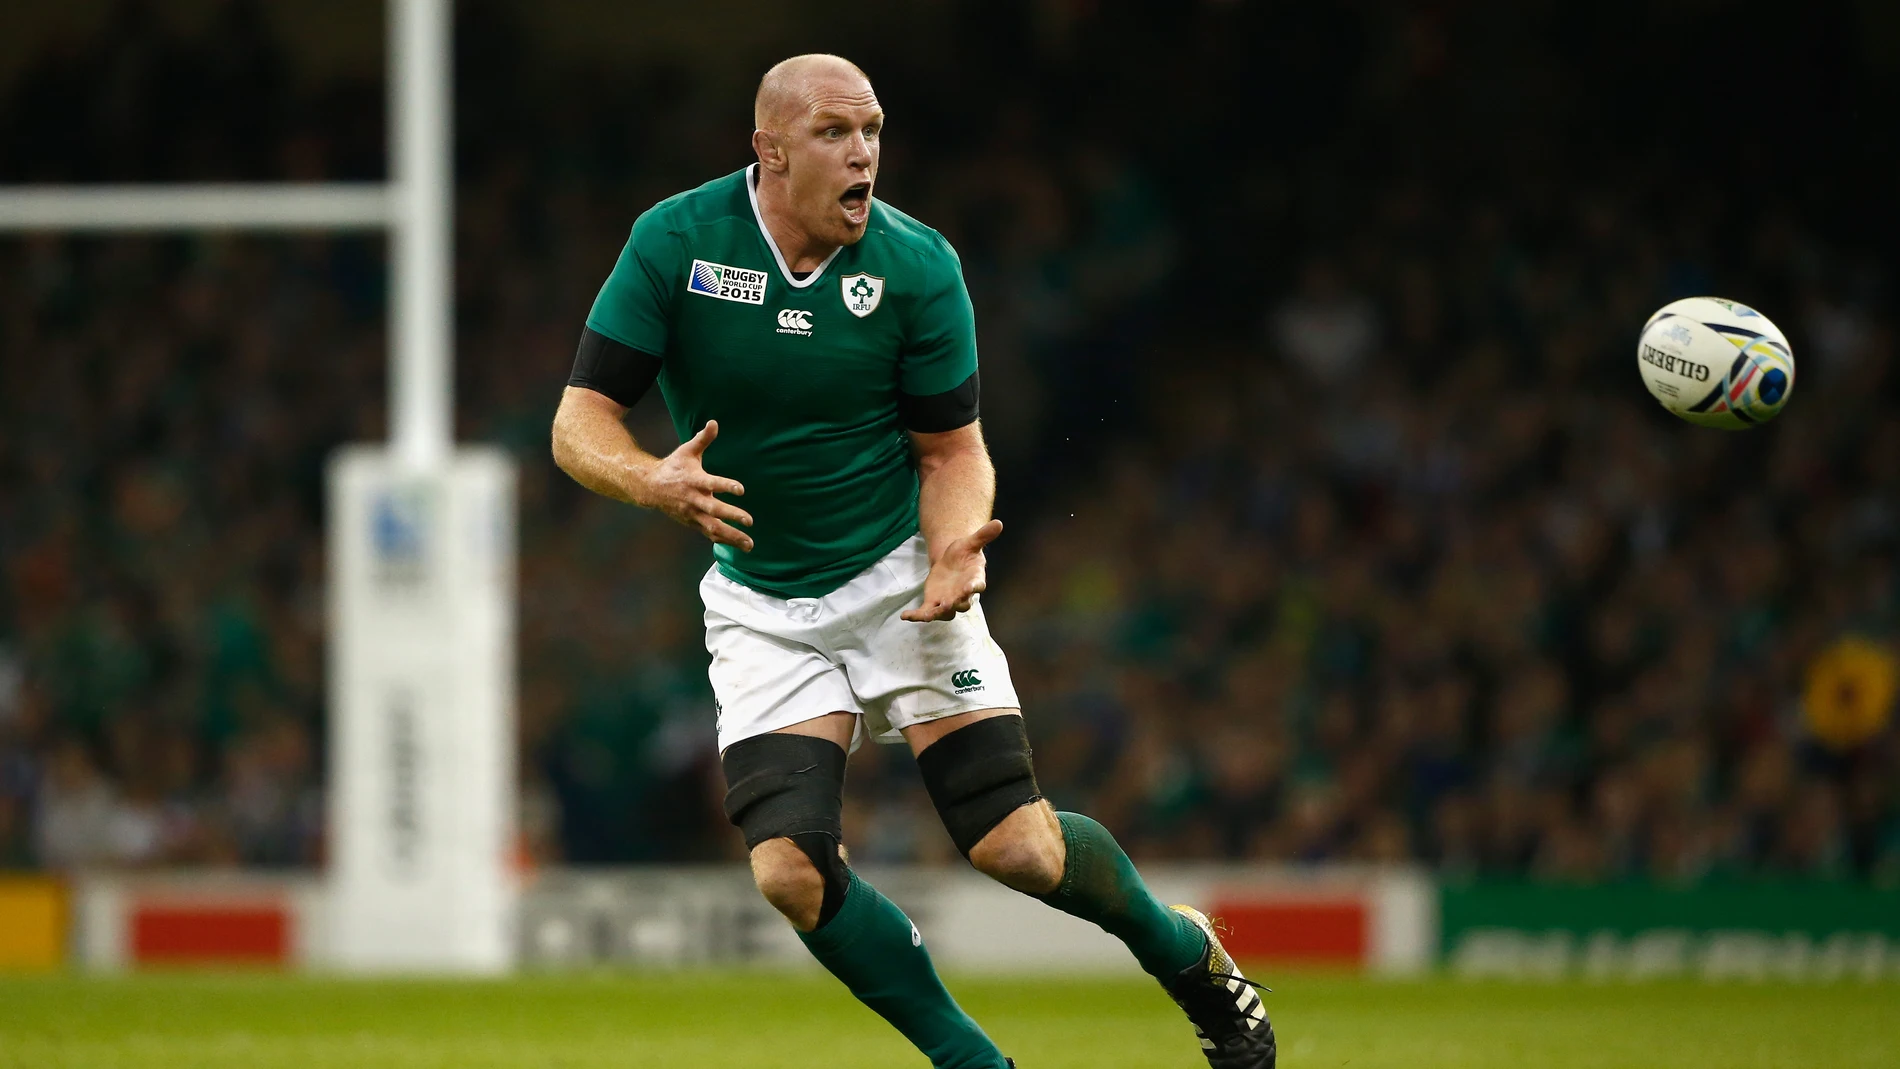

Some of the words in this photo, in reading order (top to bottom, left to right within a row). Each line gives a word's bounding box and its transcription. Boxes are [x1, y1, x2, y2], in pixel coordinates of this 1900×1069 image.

[723, 268, 765, 284] RUGBY
[722, 279, 748, 288] WORLD
[720, 286, 761, 301] 2015
[852, 303, 871, 311] IRFU
[776, 328, 813, 338] canterbury
[1642, 344, 1710, 383] GILBERT
[954, 685, 985, 695] canterbury
